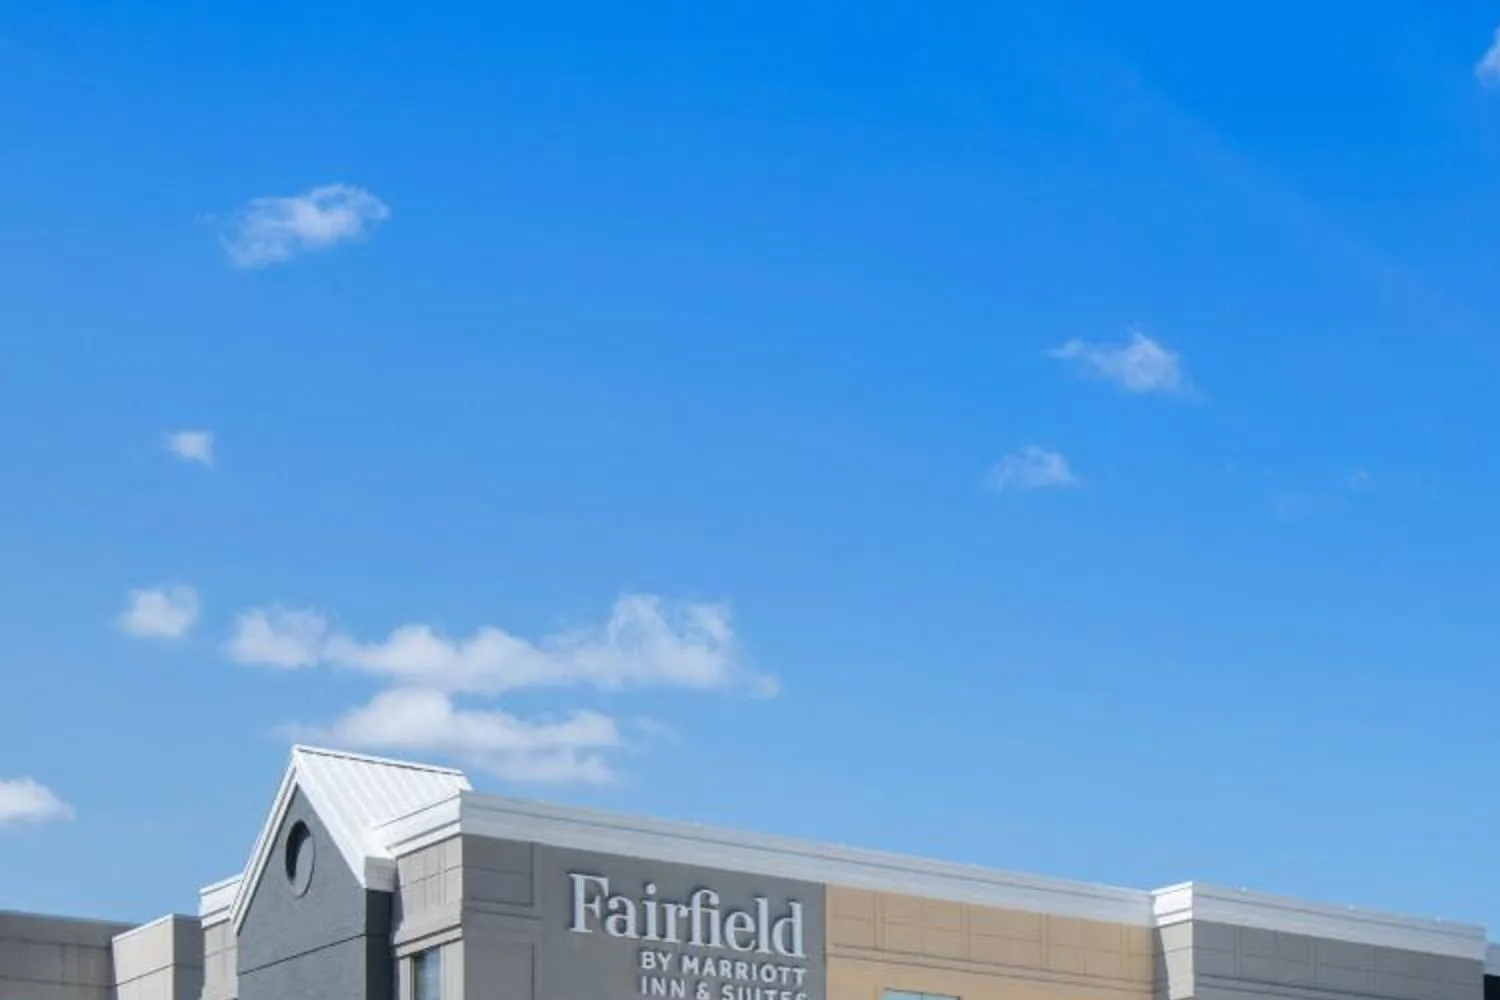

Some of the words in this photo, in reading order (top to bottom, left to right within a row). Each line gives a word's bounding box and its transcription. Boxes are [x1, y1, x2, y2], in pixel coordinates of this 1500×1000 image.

[567, 873, 806, 958] Fairfield
[640, 951, 672, 971] BY
[682, 956, 807, 985] MARRIOTT
[640, 976, 685, 998] INN
[696, 981, 710, 1000] &
